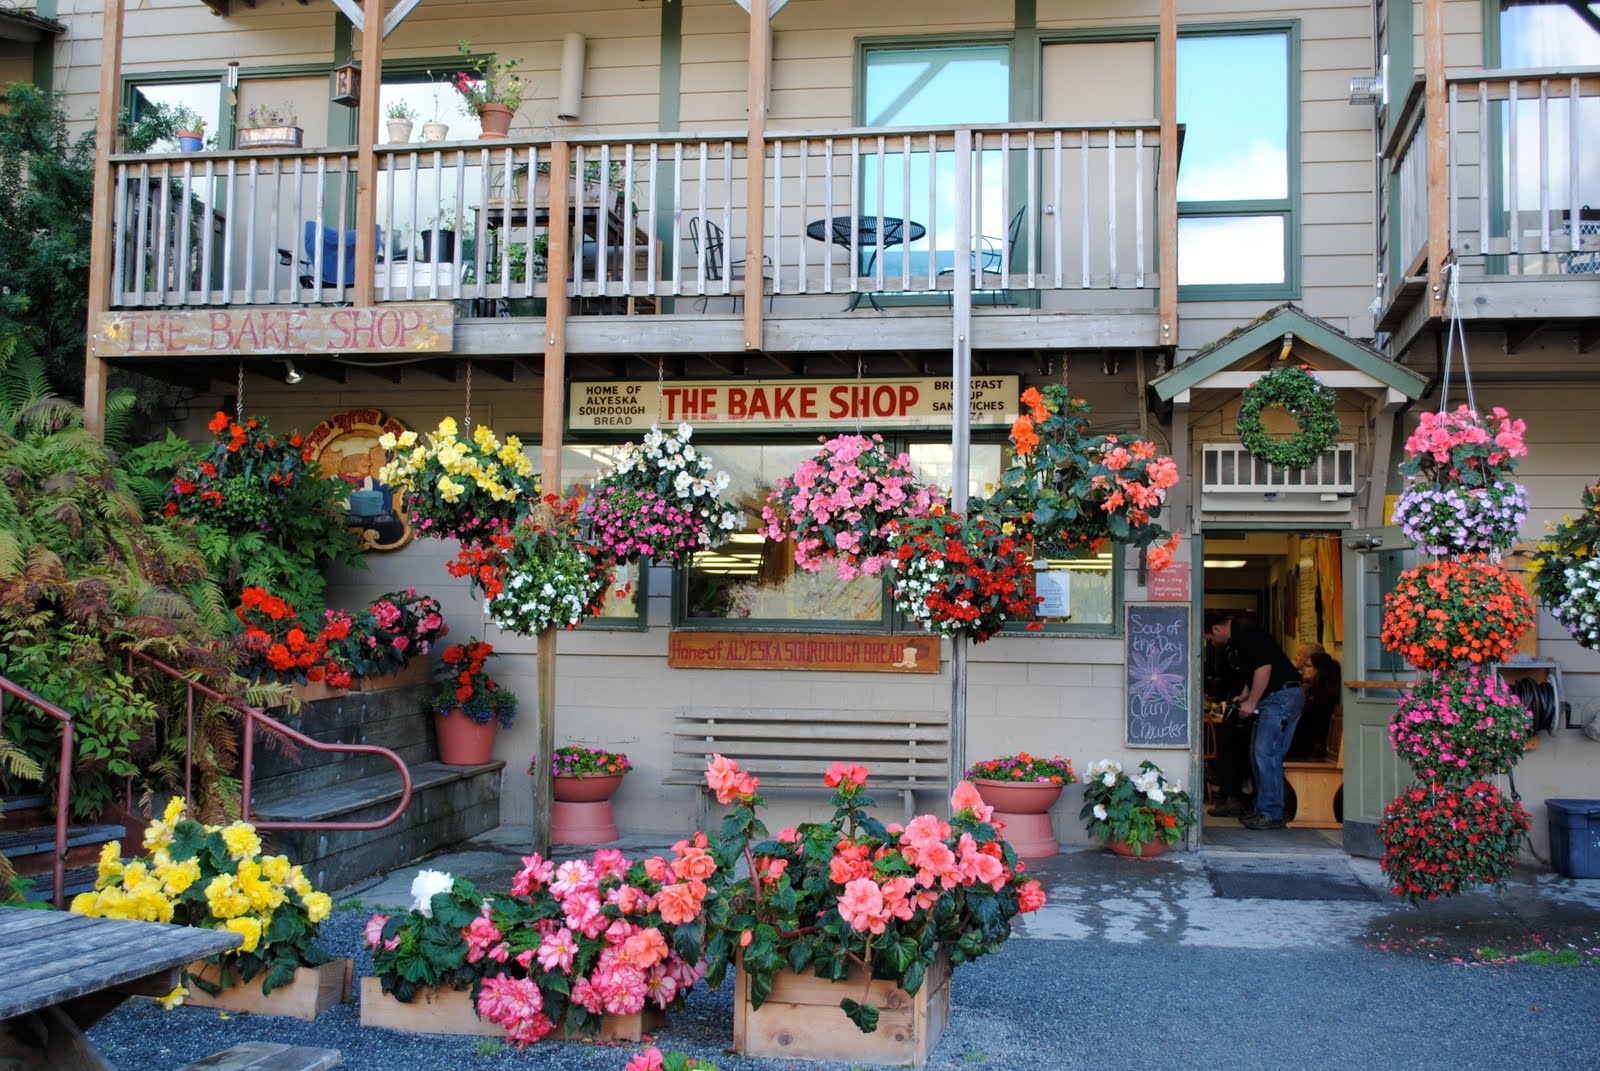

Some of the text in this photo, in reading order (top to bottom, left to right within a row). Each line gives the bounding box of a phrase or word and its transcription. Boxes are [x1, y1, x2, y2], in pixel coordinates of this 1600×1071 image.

[124, 309, 425, 353] THE BAKE SHOP
[586, 385, 642, 395] HOME OF
[934, 380, 1004, 390] BRFAST
[578, 406, 646, 415] SOURDOUGH
[586, 396, 638, 405] ALYESKA
[662, 385, 920, 420] THE BAKE SHOP
[932, 401, 1005, 411] SANICHES
[593, 416, 632, 425] BREAD
[1130, 614, 1182, 639] Soup of
[708, 639, 725, 660] of
[725, 639, 783, 662] ALYESKA
[784, 640, 860, 663] SOURDOUGH
[863, 641, 904, 664] BREAD
[1132, 635, 1184, 665] the Day
[1130, 693, 1171, 724] Clam
[1130, 716, 1187, 740] Chowder
